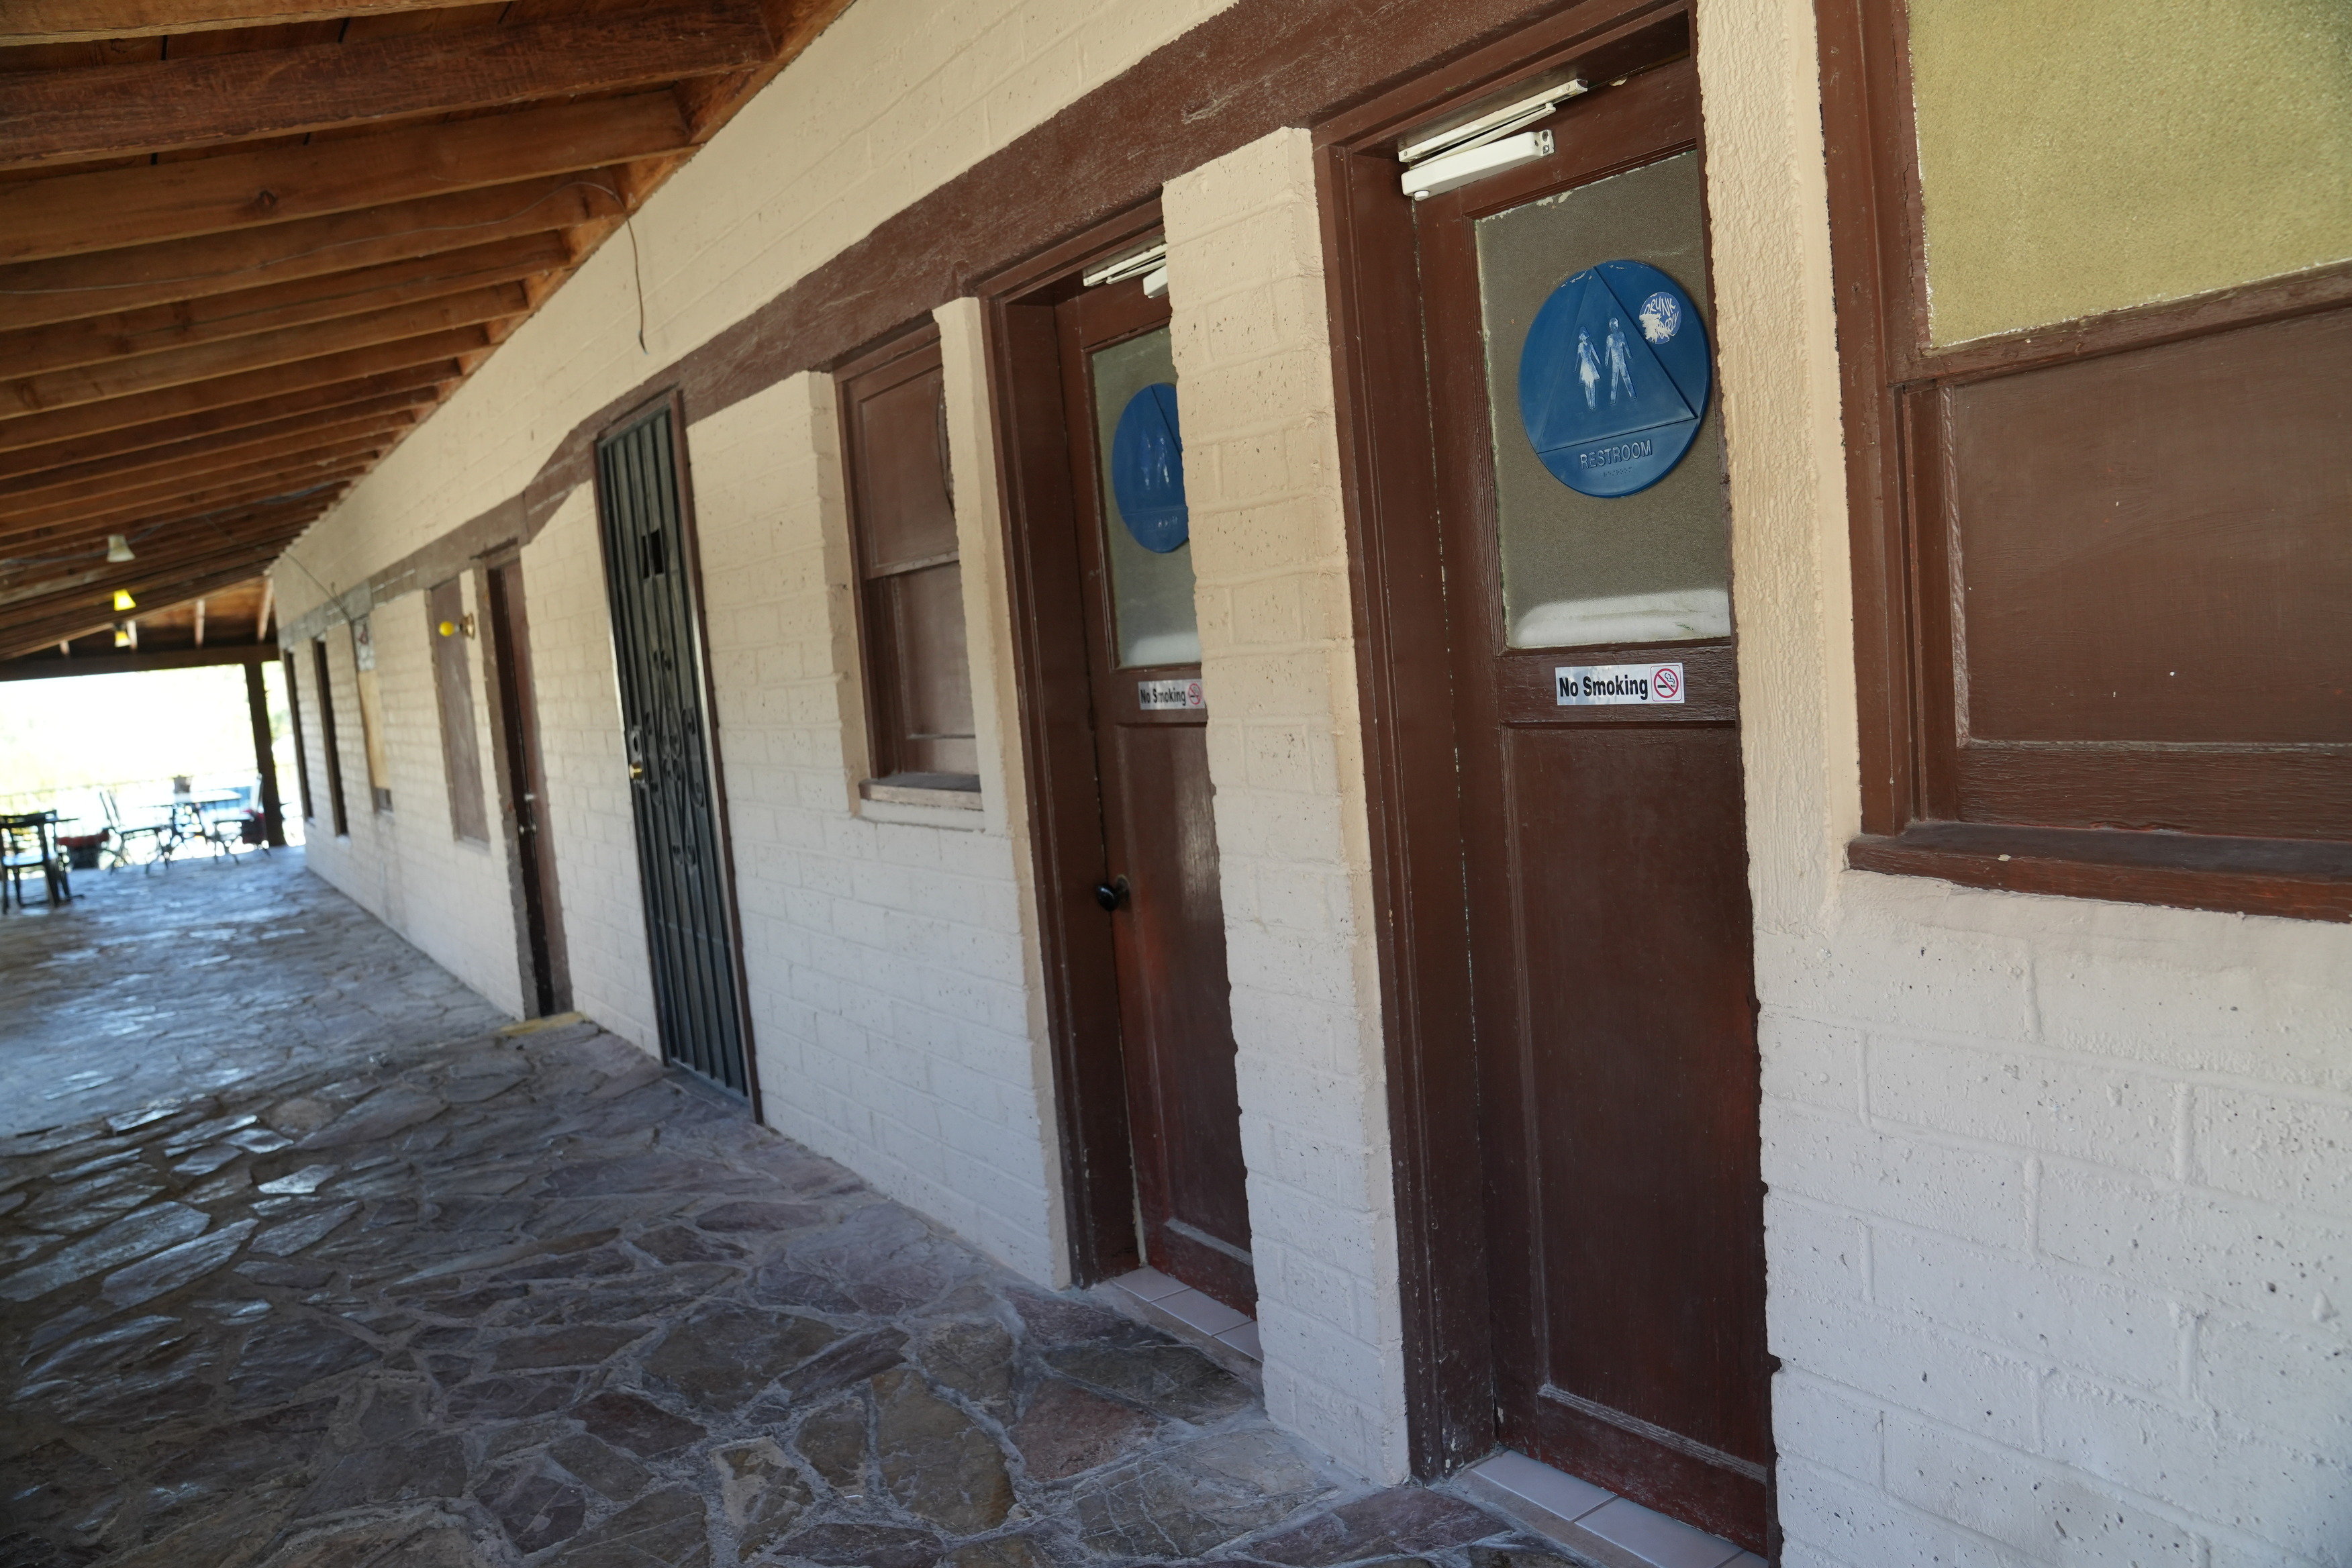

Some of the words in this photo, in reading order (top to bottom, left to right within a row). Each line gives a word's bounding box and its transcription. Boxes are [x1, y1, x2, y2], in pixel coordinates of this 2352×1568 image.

[1643, 296, 1676, 317] DRUNK
[1579, 439, 1653, 469] RESTROOM
[1140, 689, 1150, 704] No
[1153, 687, 1187, 707] Smoking
[1559, 677, 1579, 697] No
[1583, 674, 1649, 701] Smoking
